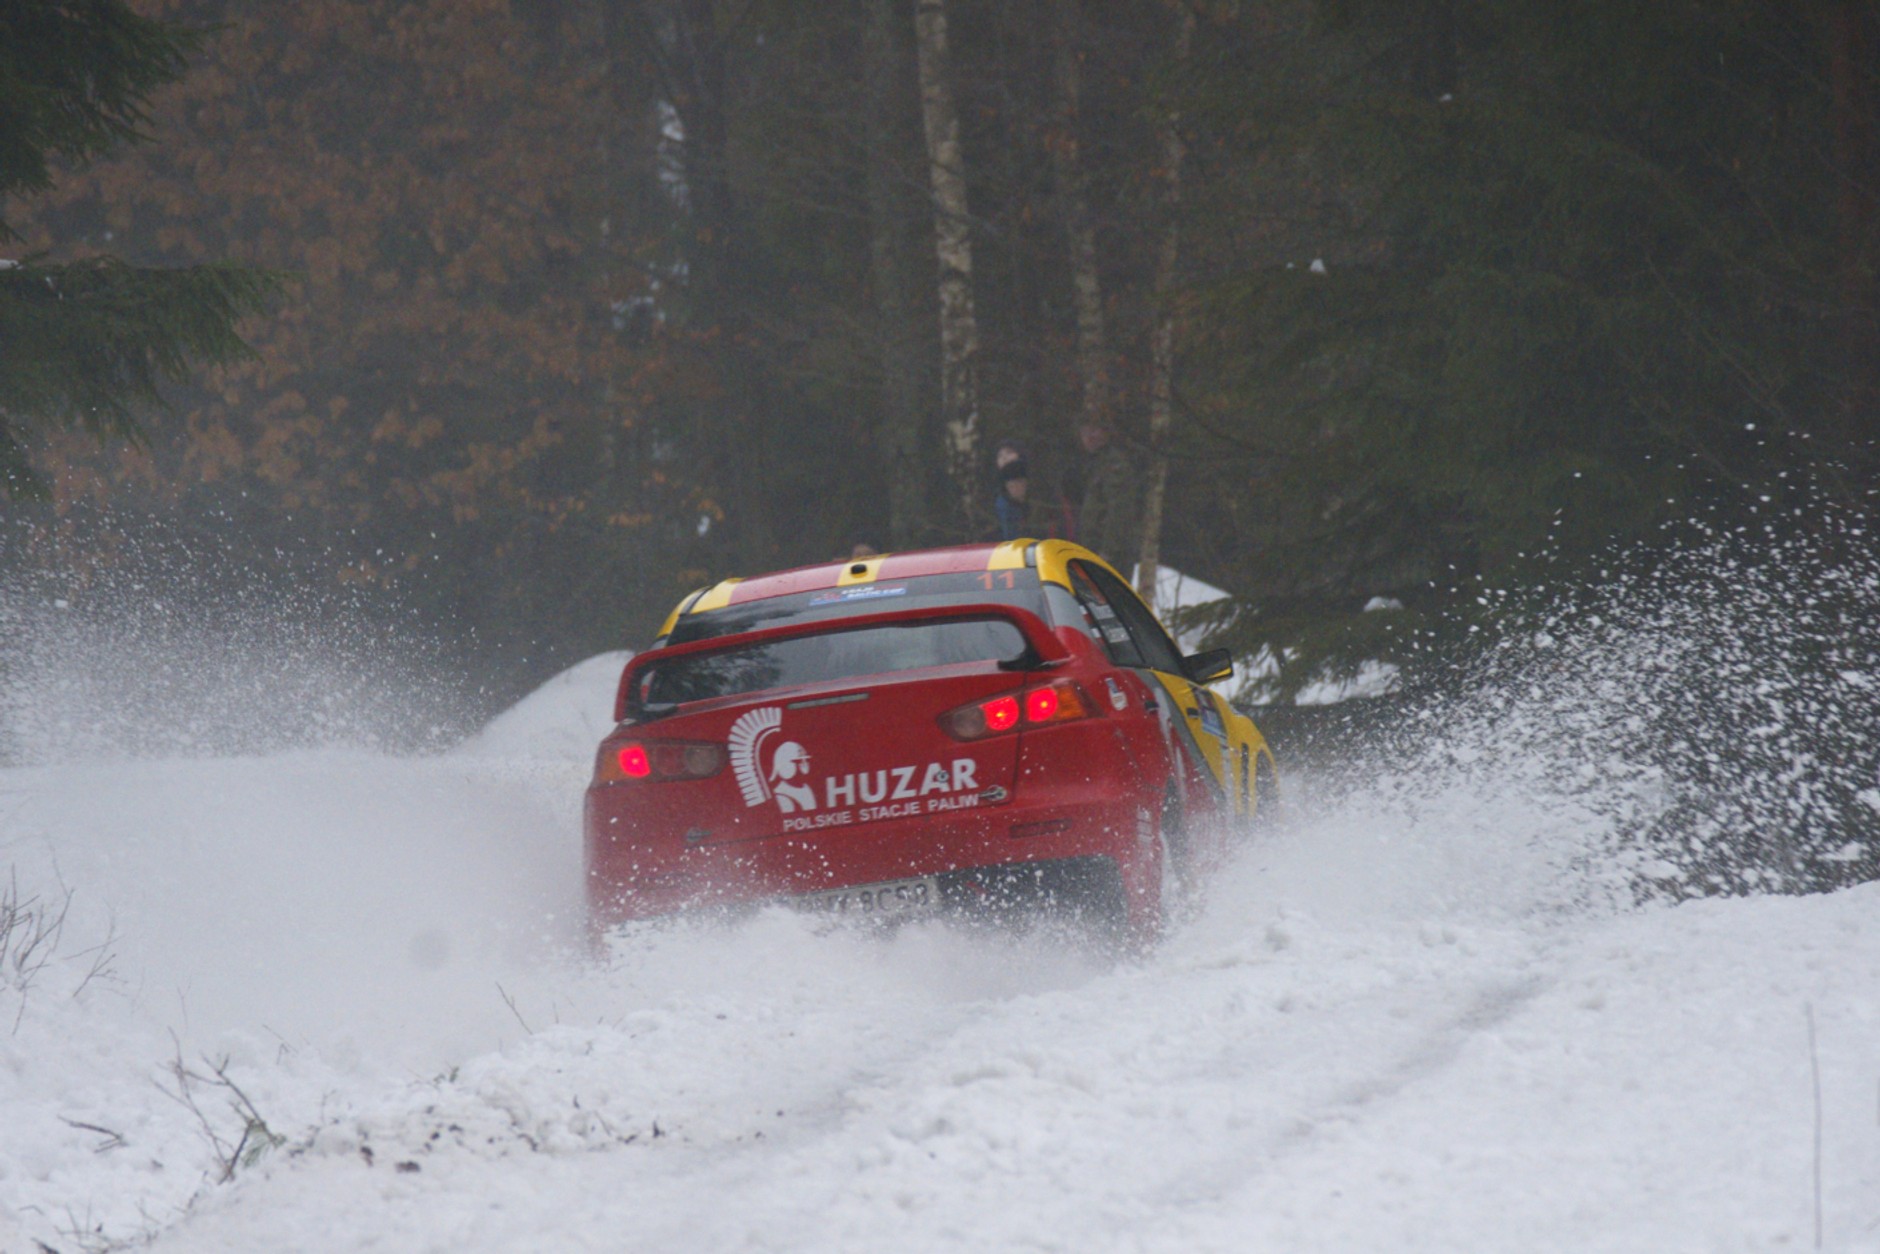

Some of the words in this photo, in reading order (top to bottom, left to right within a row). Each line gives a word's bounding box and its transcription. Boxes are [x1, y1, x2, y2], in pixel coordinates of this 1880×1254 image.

[977, 570, 1015, 590] 11
[826, 758, 980, 808] HUZAR
[783, 811, 852, 832] POLSKIE
[859, 799, 922, 822] STACJE
[928, 793, 980, 813] PALIW
